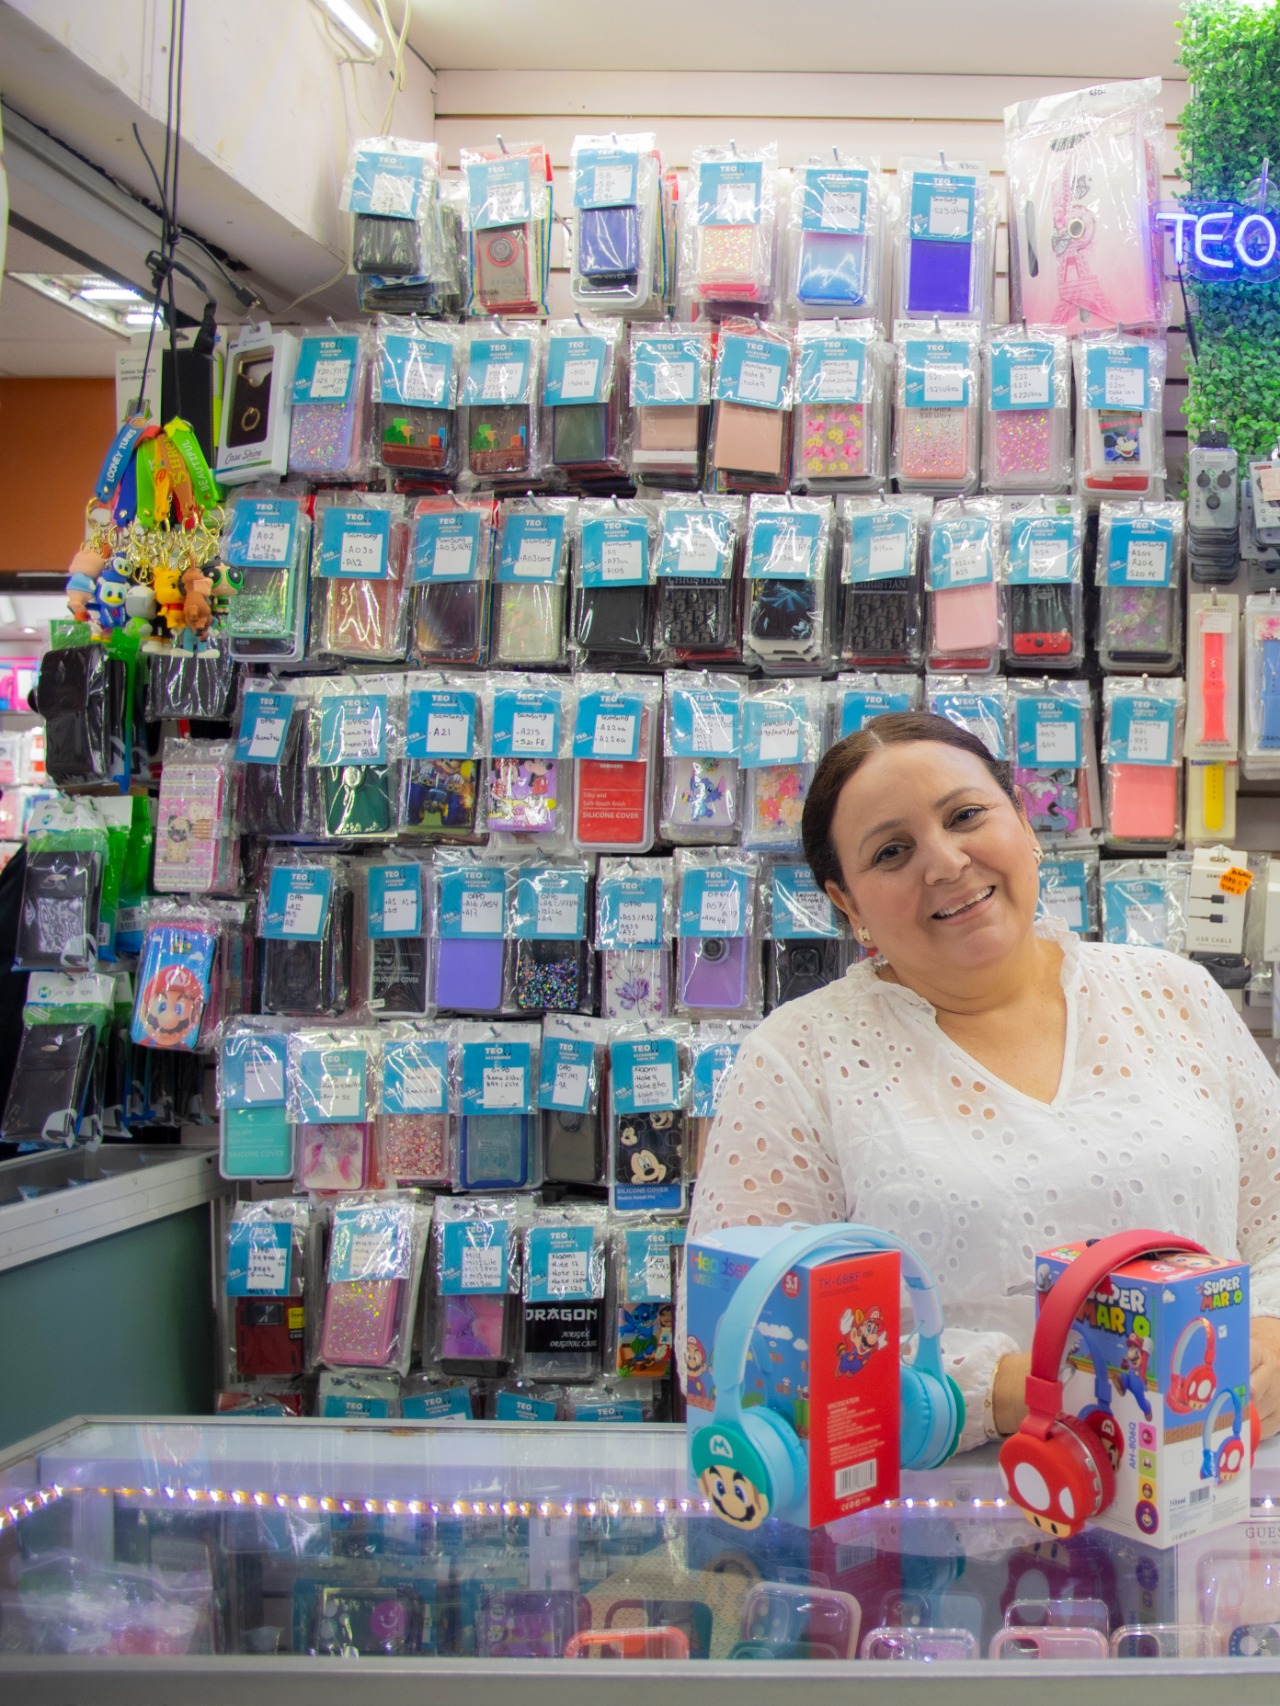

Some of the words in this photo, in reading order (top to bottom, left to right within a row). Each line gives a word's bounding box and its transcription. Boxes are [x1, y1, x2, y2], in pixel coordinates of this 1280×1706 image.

[1156, 211, 1277, 269] TEO
[106, 450, 123, 483] LOONEY
[119, 428, 137, 450] TUNES
[226, 452, 242, 464] Case
[244, 449, 263, 459] Shine
[182, 440, 210, 492] BEAUTIFUL
[691, 1251, 748, 1279] Headset
[785, 1274, 799, 1290] 5.1
[817, 1271, 861, 1290] TK-688F
[1204, 1276, 1240, 1295] SUPER
[526, 1309, 597, 1320] DRAGON
